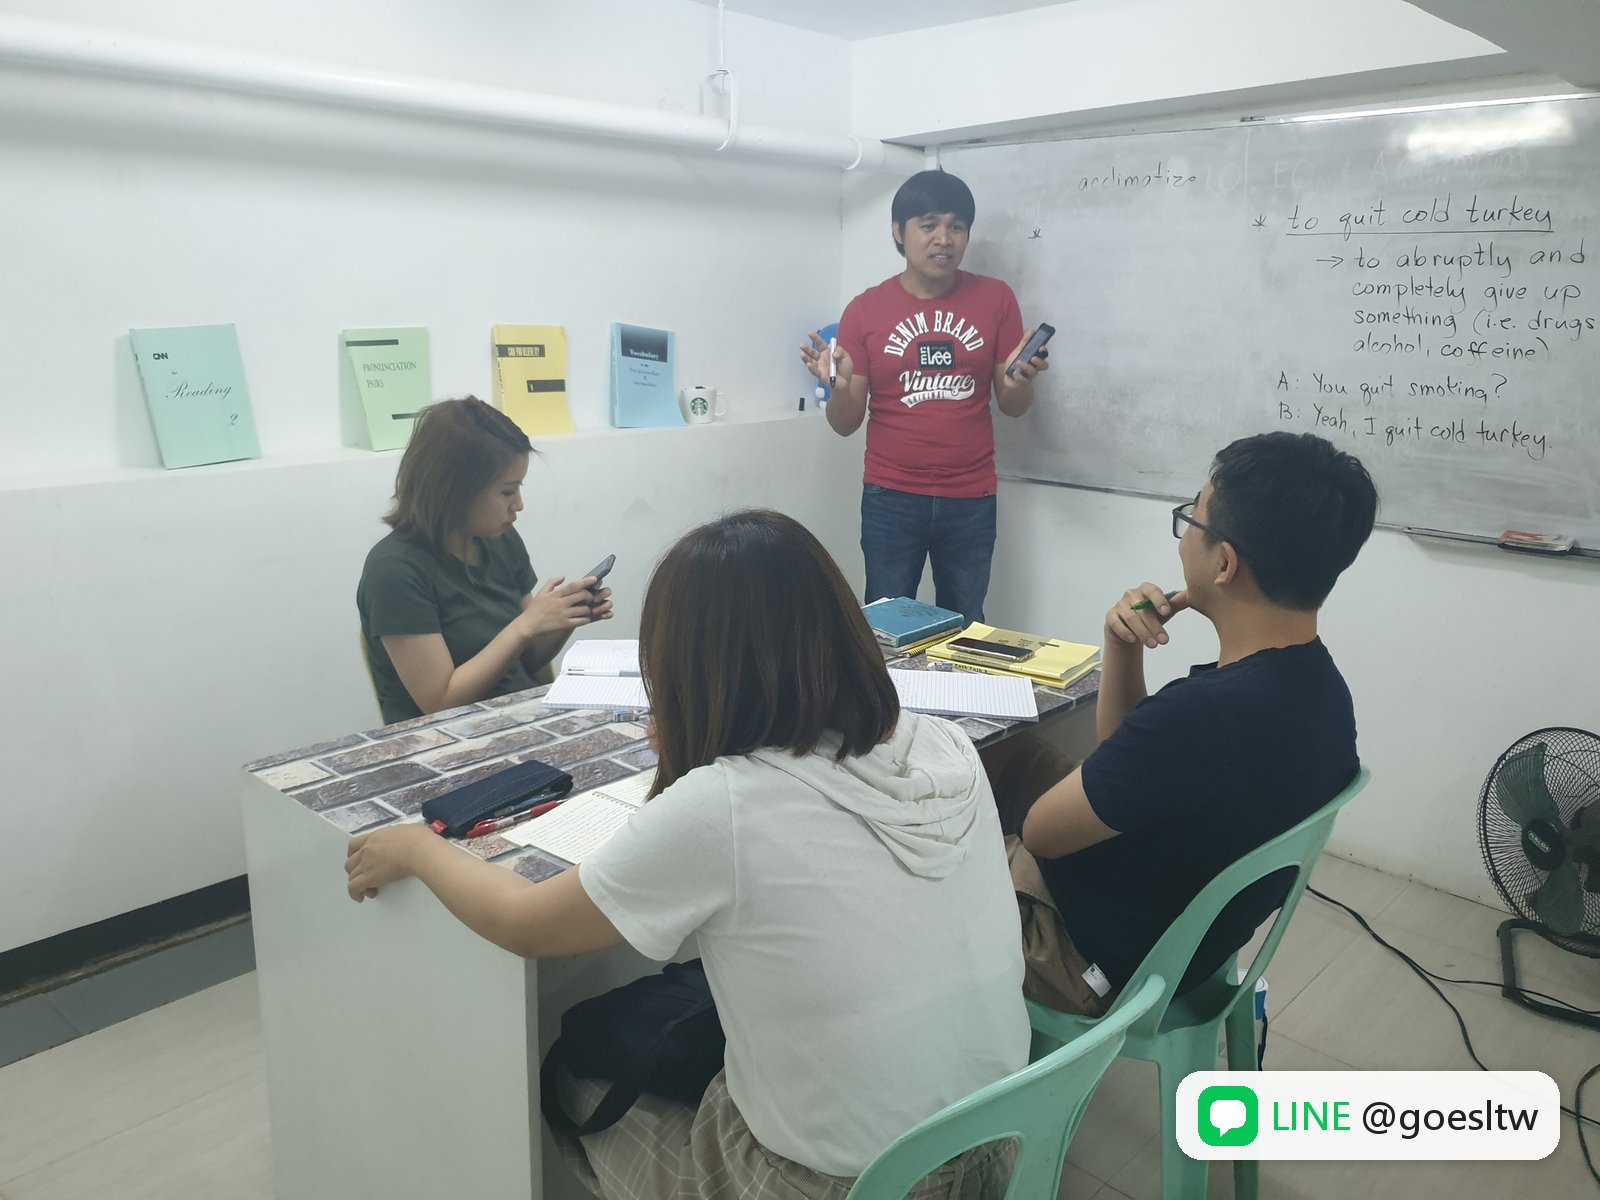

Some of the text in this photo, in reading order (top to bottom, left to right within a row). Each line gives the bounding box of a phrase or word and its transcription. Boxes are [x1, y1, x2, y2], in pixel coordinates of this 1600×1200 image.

[1288, 194, 1552, 241] to quit cold turkey
[1357, 238, 1586, 278] to abruptly and
[1352, 277, 1582, 315] completely give up
[884, 310, 984, 357] DENIM BRAND
[1353, 306, 1458, 339] something
[152, 352, 168, 360] CNN
[927, 346, 952, 365] Lee
[165, 381, 232, 400] Reading
[899, 370, 975, 396] Vintage
[907, 390, 946, 405] ORIGINAL
[1312, 373, 1348, 395] You
[1360, 375, 1394, 406] quit
[1408, 373, 1508, 403] smoking?
[1364, 416, 1377, 436] I
[1386, 417, 1423, 447] quit
[1430, 418, 1466, 444] cold
